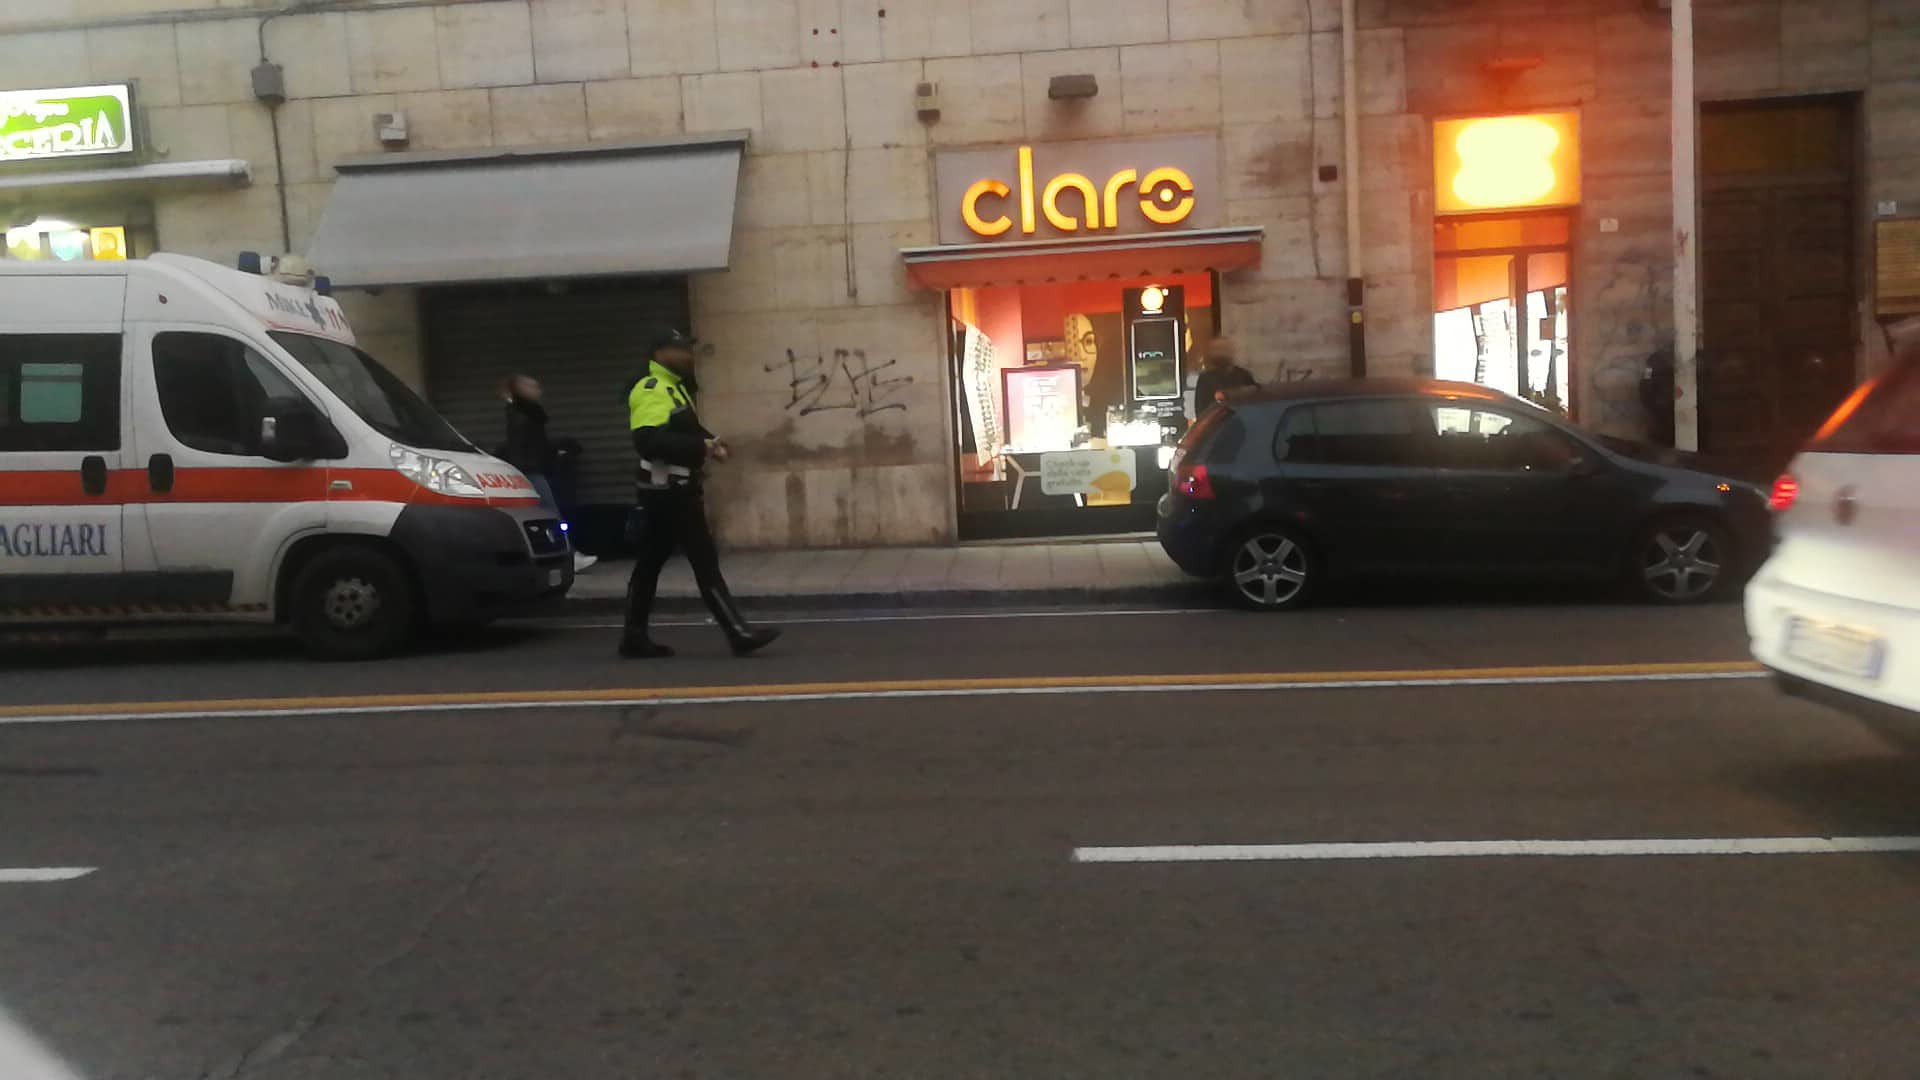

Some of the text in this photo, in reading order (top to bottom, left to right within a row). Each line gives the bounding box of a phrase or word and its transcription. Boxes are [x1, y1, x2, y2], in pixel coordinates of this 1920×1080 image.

[0, 108, 118, 155] CERIA
[960, 145, 1196, 237] claro
[0, 522, 107, 557] AGLIARI
